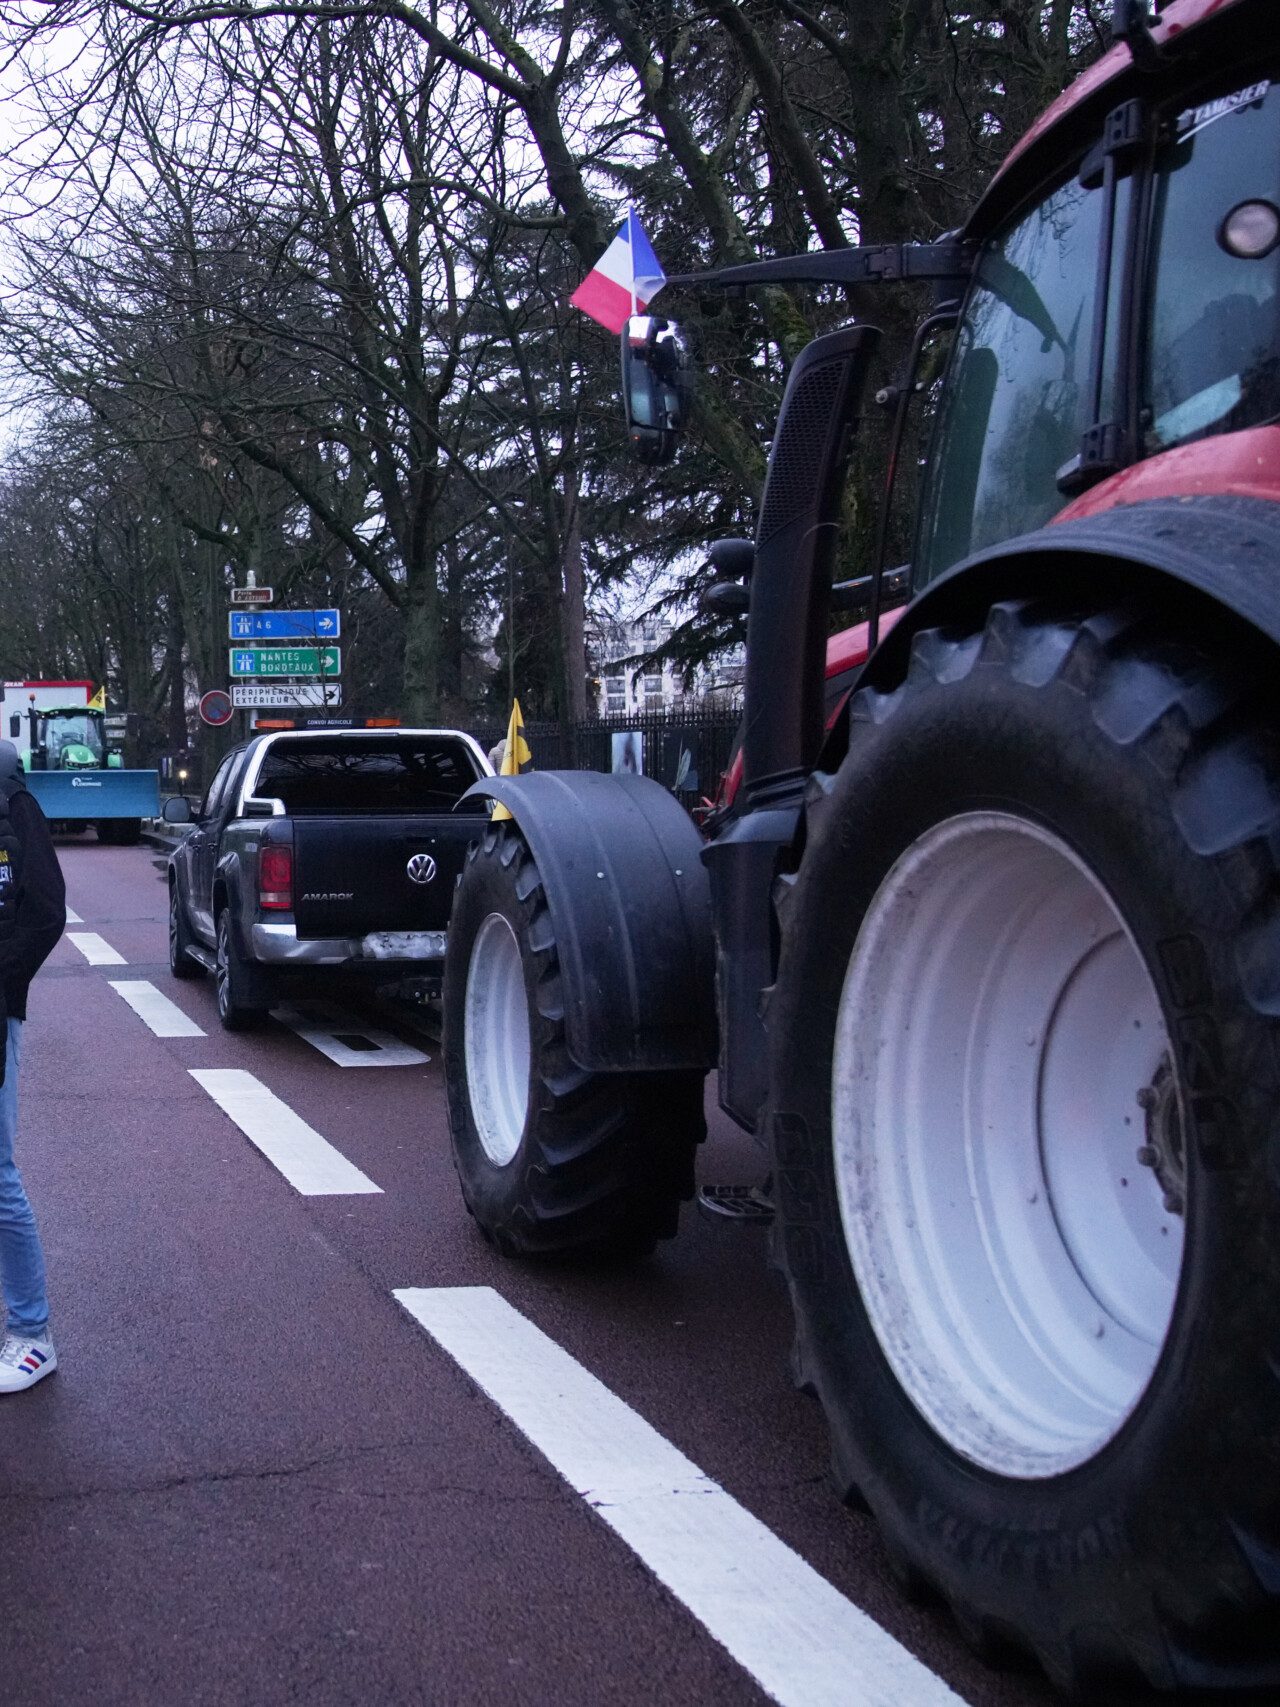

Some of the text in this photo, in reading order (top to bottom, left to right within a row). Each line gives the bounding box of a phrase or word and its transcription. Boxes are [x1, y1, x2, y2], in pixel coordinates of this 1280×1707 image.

[256, 620, 272, 630] A 6
[260, 652, 300, 662] NANTES
[260, 662, 314, 673] BORDEAUX
[235, 695, 290, 705] EXTÉRIEUR
[301, 892, 355, 901] AMAROK
